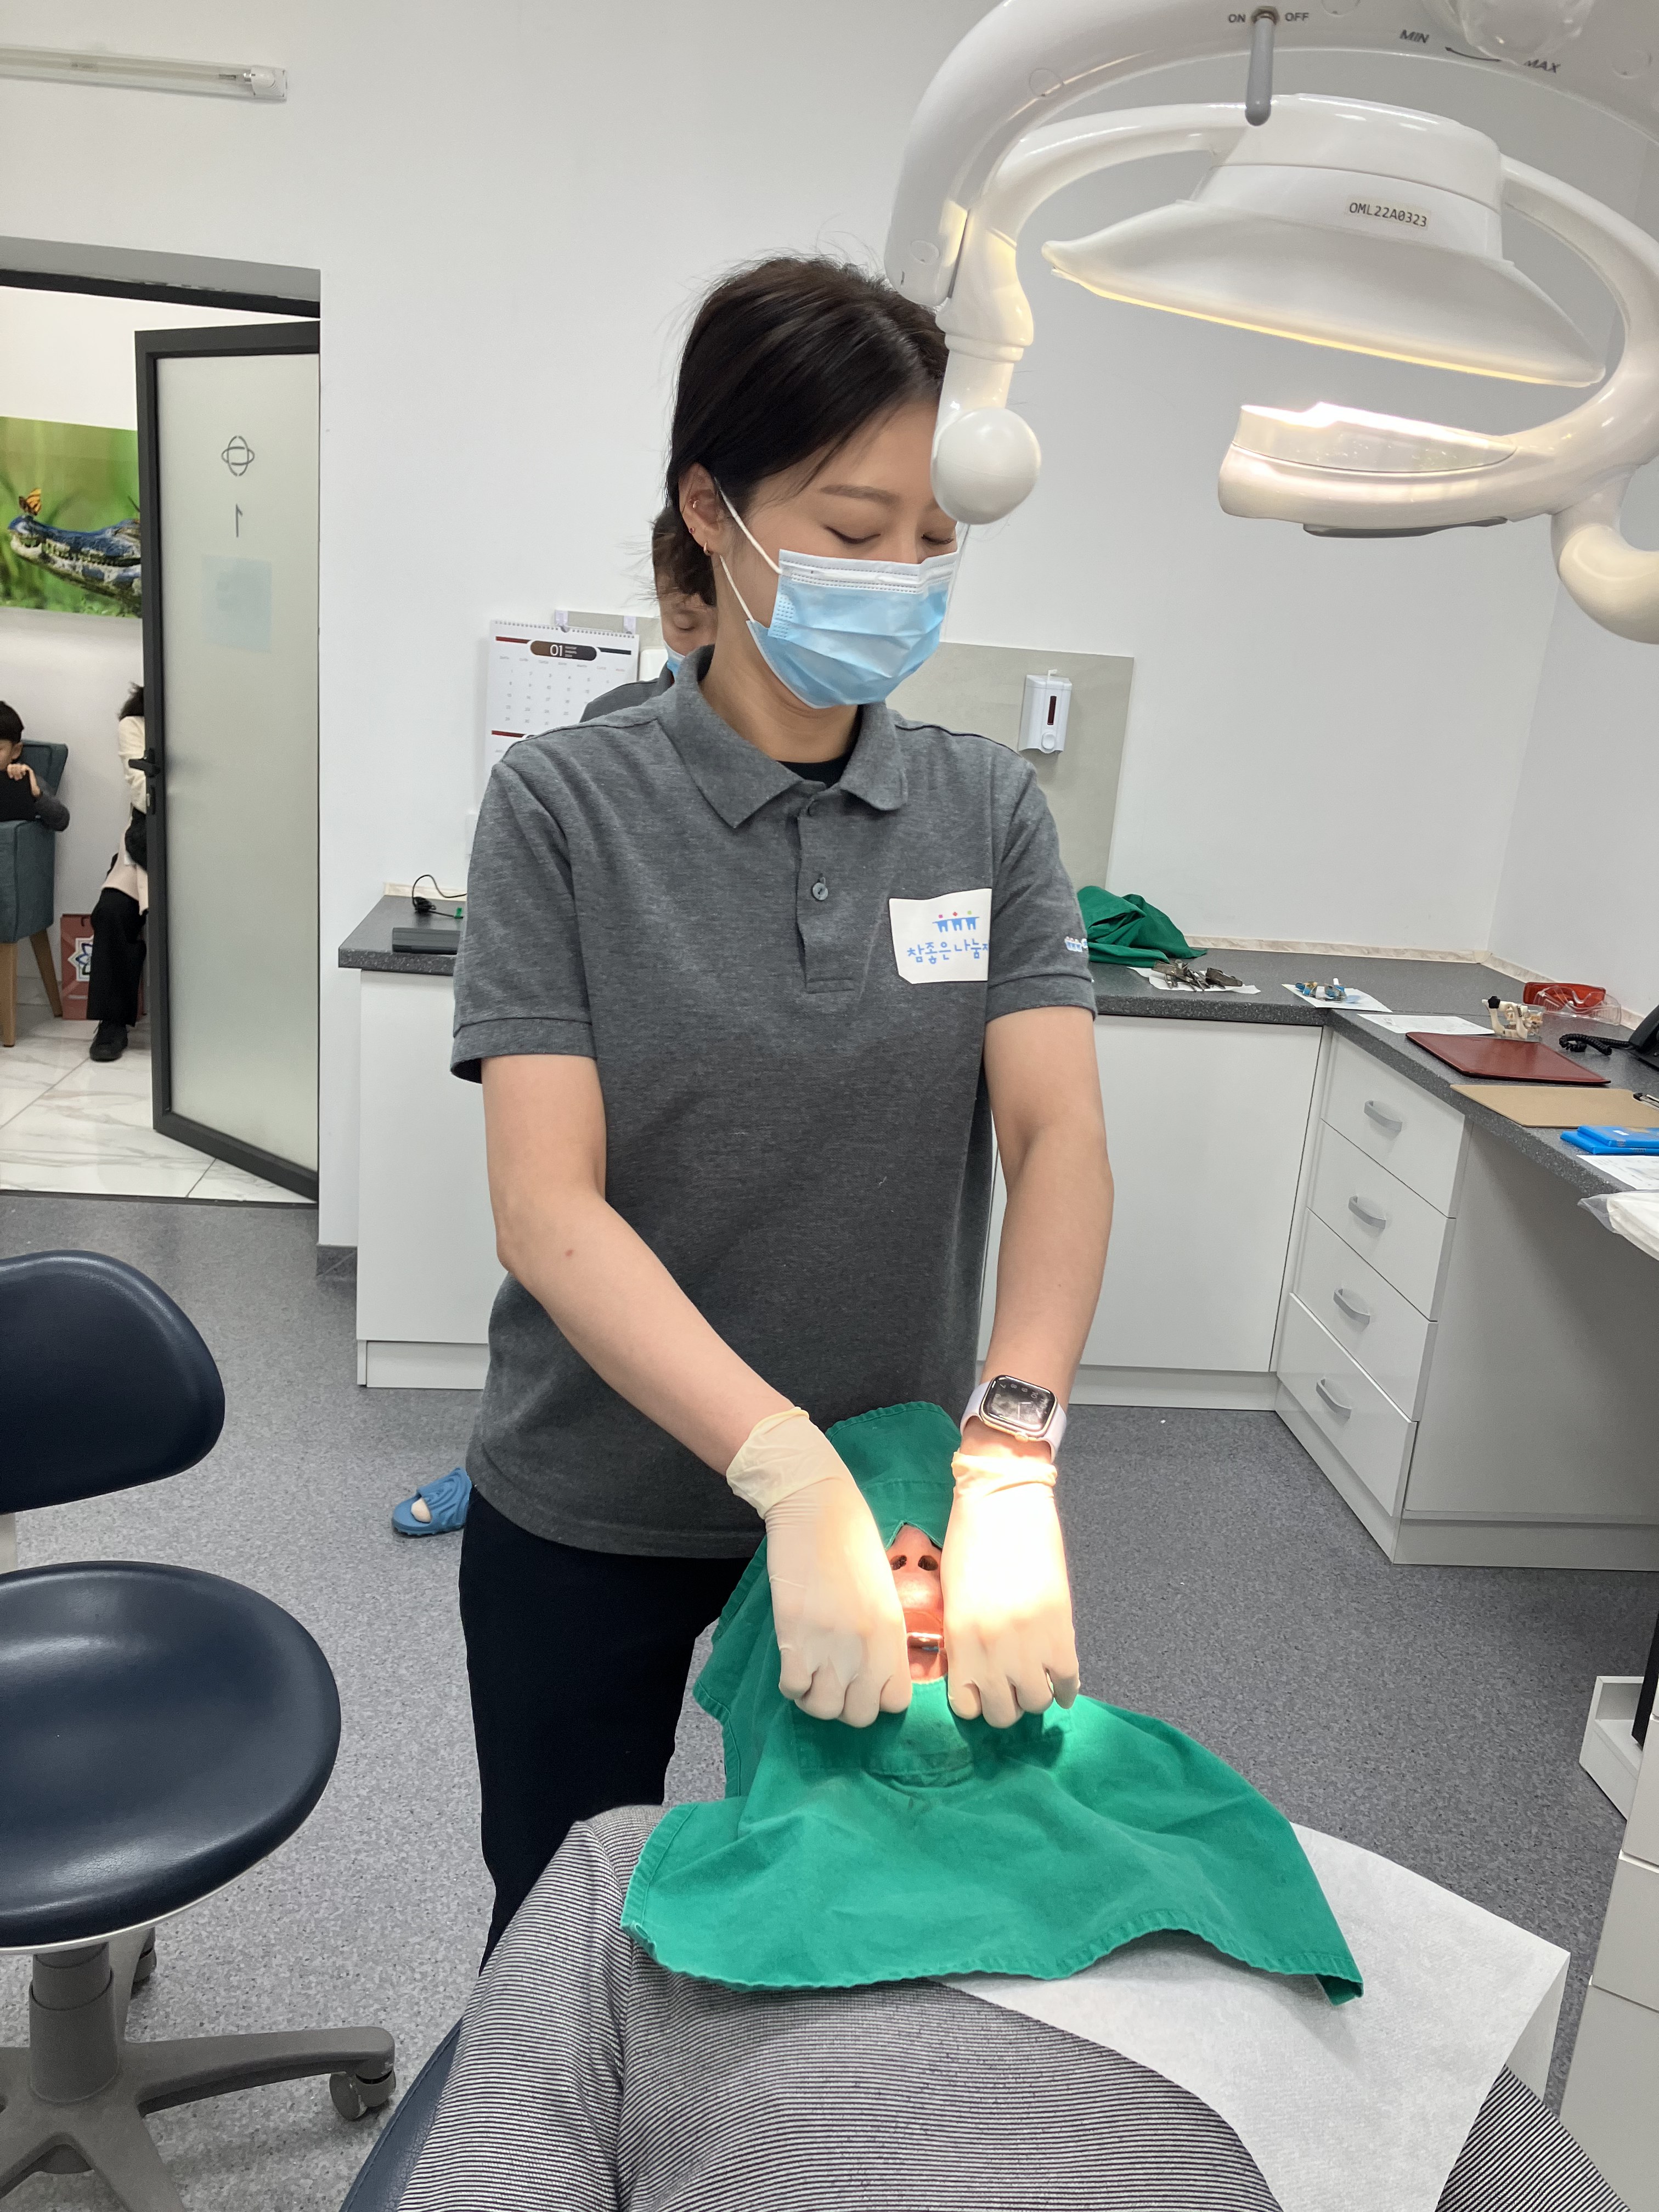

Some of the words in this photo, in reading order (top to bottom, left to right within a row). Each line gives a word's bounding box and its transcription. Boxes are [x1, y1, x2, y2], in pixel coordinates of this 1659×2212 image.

[1228, 14, 1246, 23] ON
[1285, 12, 1310, 21] OFF
[1399, 29, 1430, 43] MIN
[1524, 59, 1561, 73] MAX
[1349, 202, 1427, 227] OML22A0323
[550, 644, 563, 657] 01
